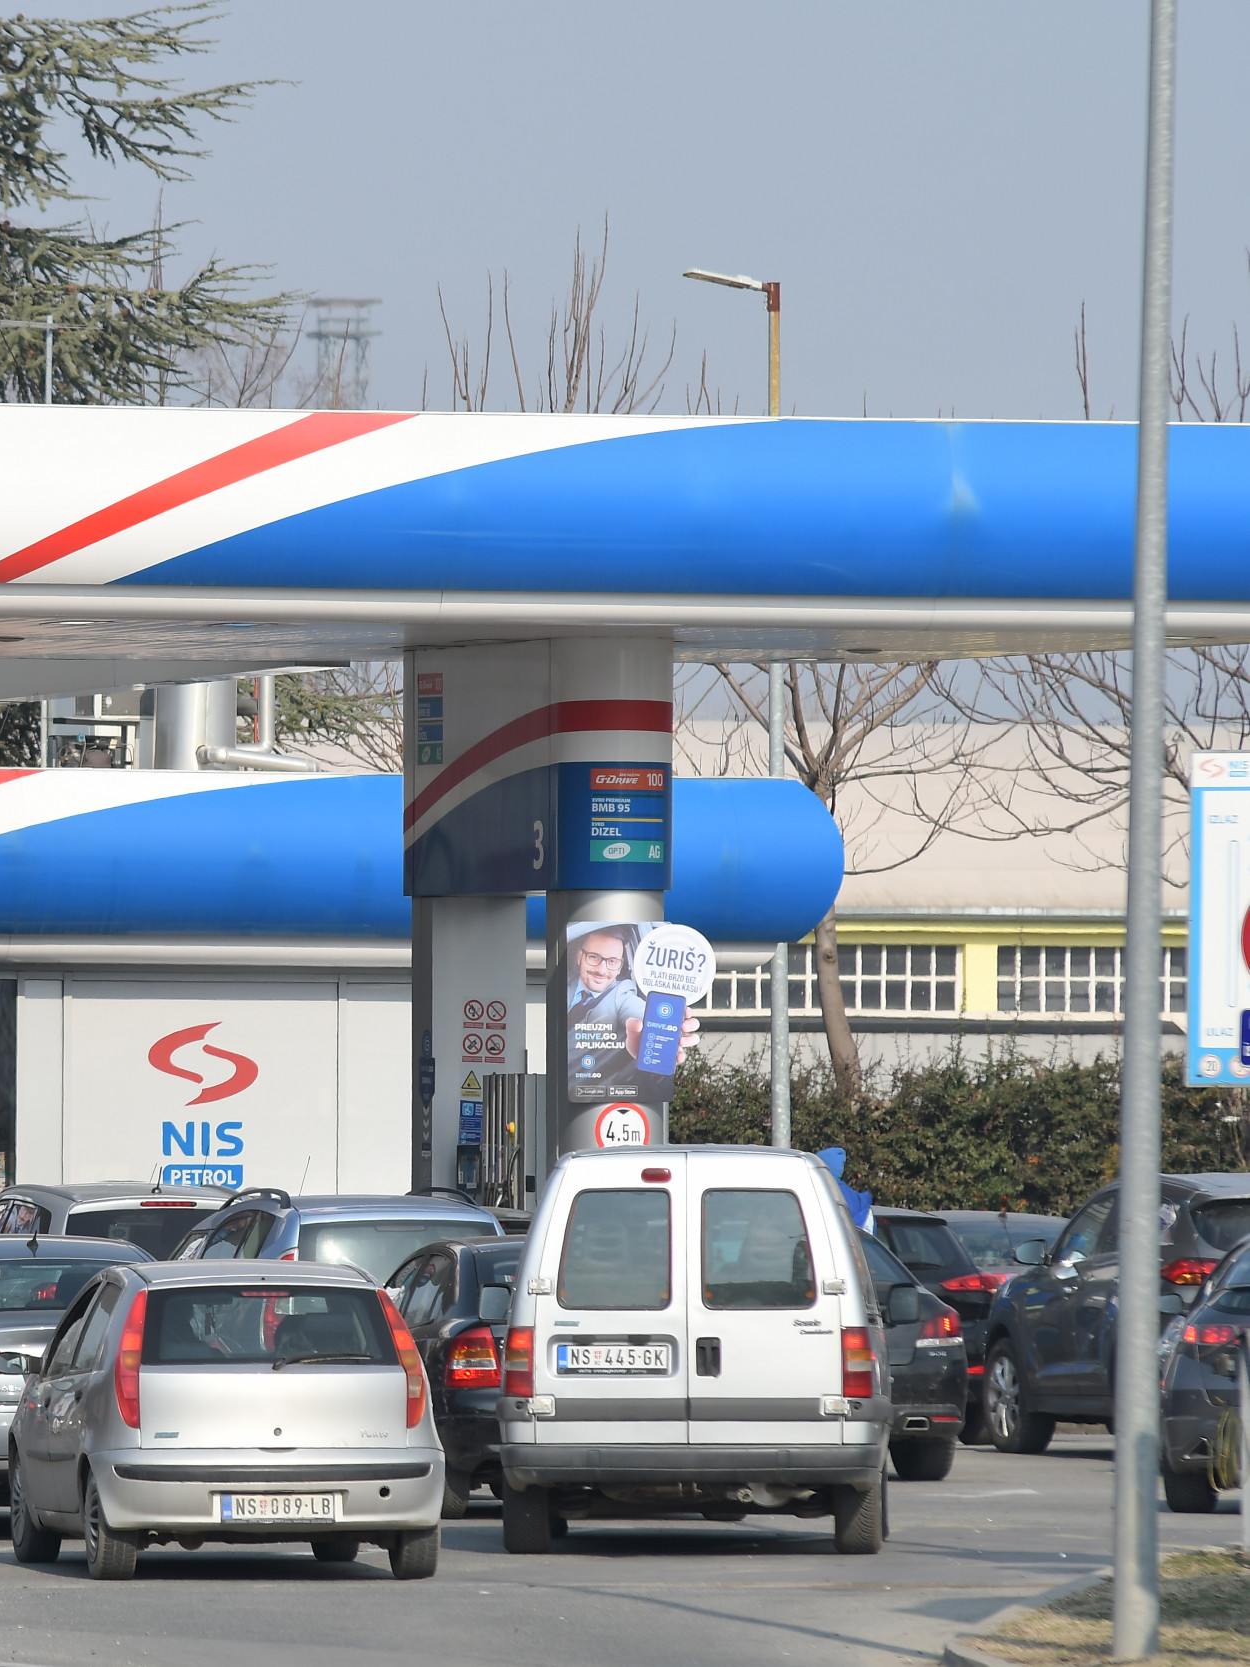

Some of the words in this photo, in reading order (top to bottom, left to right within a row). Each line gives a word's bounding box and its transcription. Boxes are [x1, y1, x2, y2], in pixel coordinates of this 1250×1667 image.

[647, 774, 663, 786] 100
[592, 803, 616, 813] BMB
[618, 804, 631, 813] 95
[591, 827, 622, 837] DIZEL
[533, 820, 544, 870] 3
[645, 941, 707, 973] ŽURIŠ?
[650, 970, 667, 979] PLATI
[685, 975, 697, 985] BEZ
[575, 1023, 612, 1031] PREUZMI
[575, 1032, 617, 1040] DRIVE.GO
[575, 1041, 625, 1049] APLIKACIJU
[162, 1121, 244, 1157] NIS
[170, 1169, 237, 1186] PETROL
[570, 1348, 591, 1366] NS
[235, 1497, 257, 1516] NS
